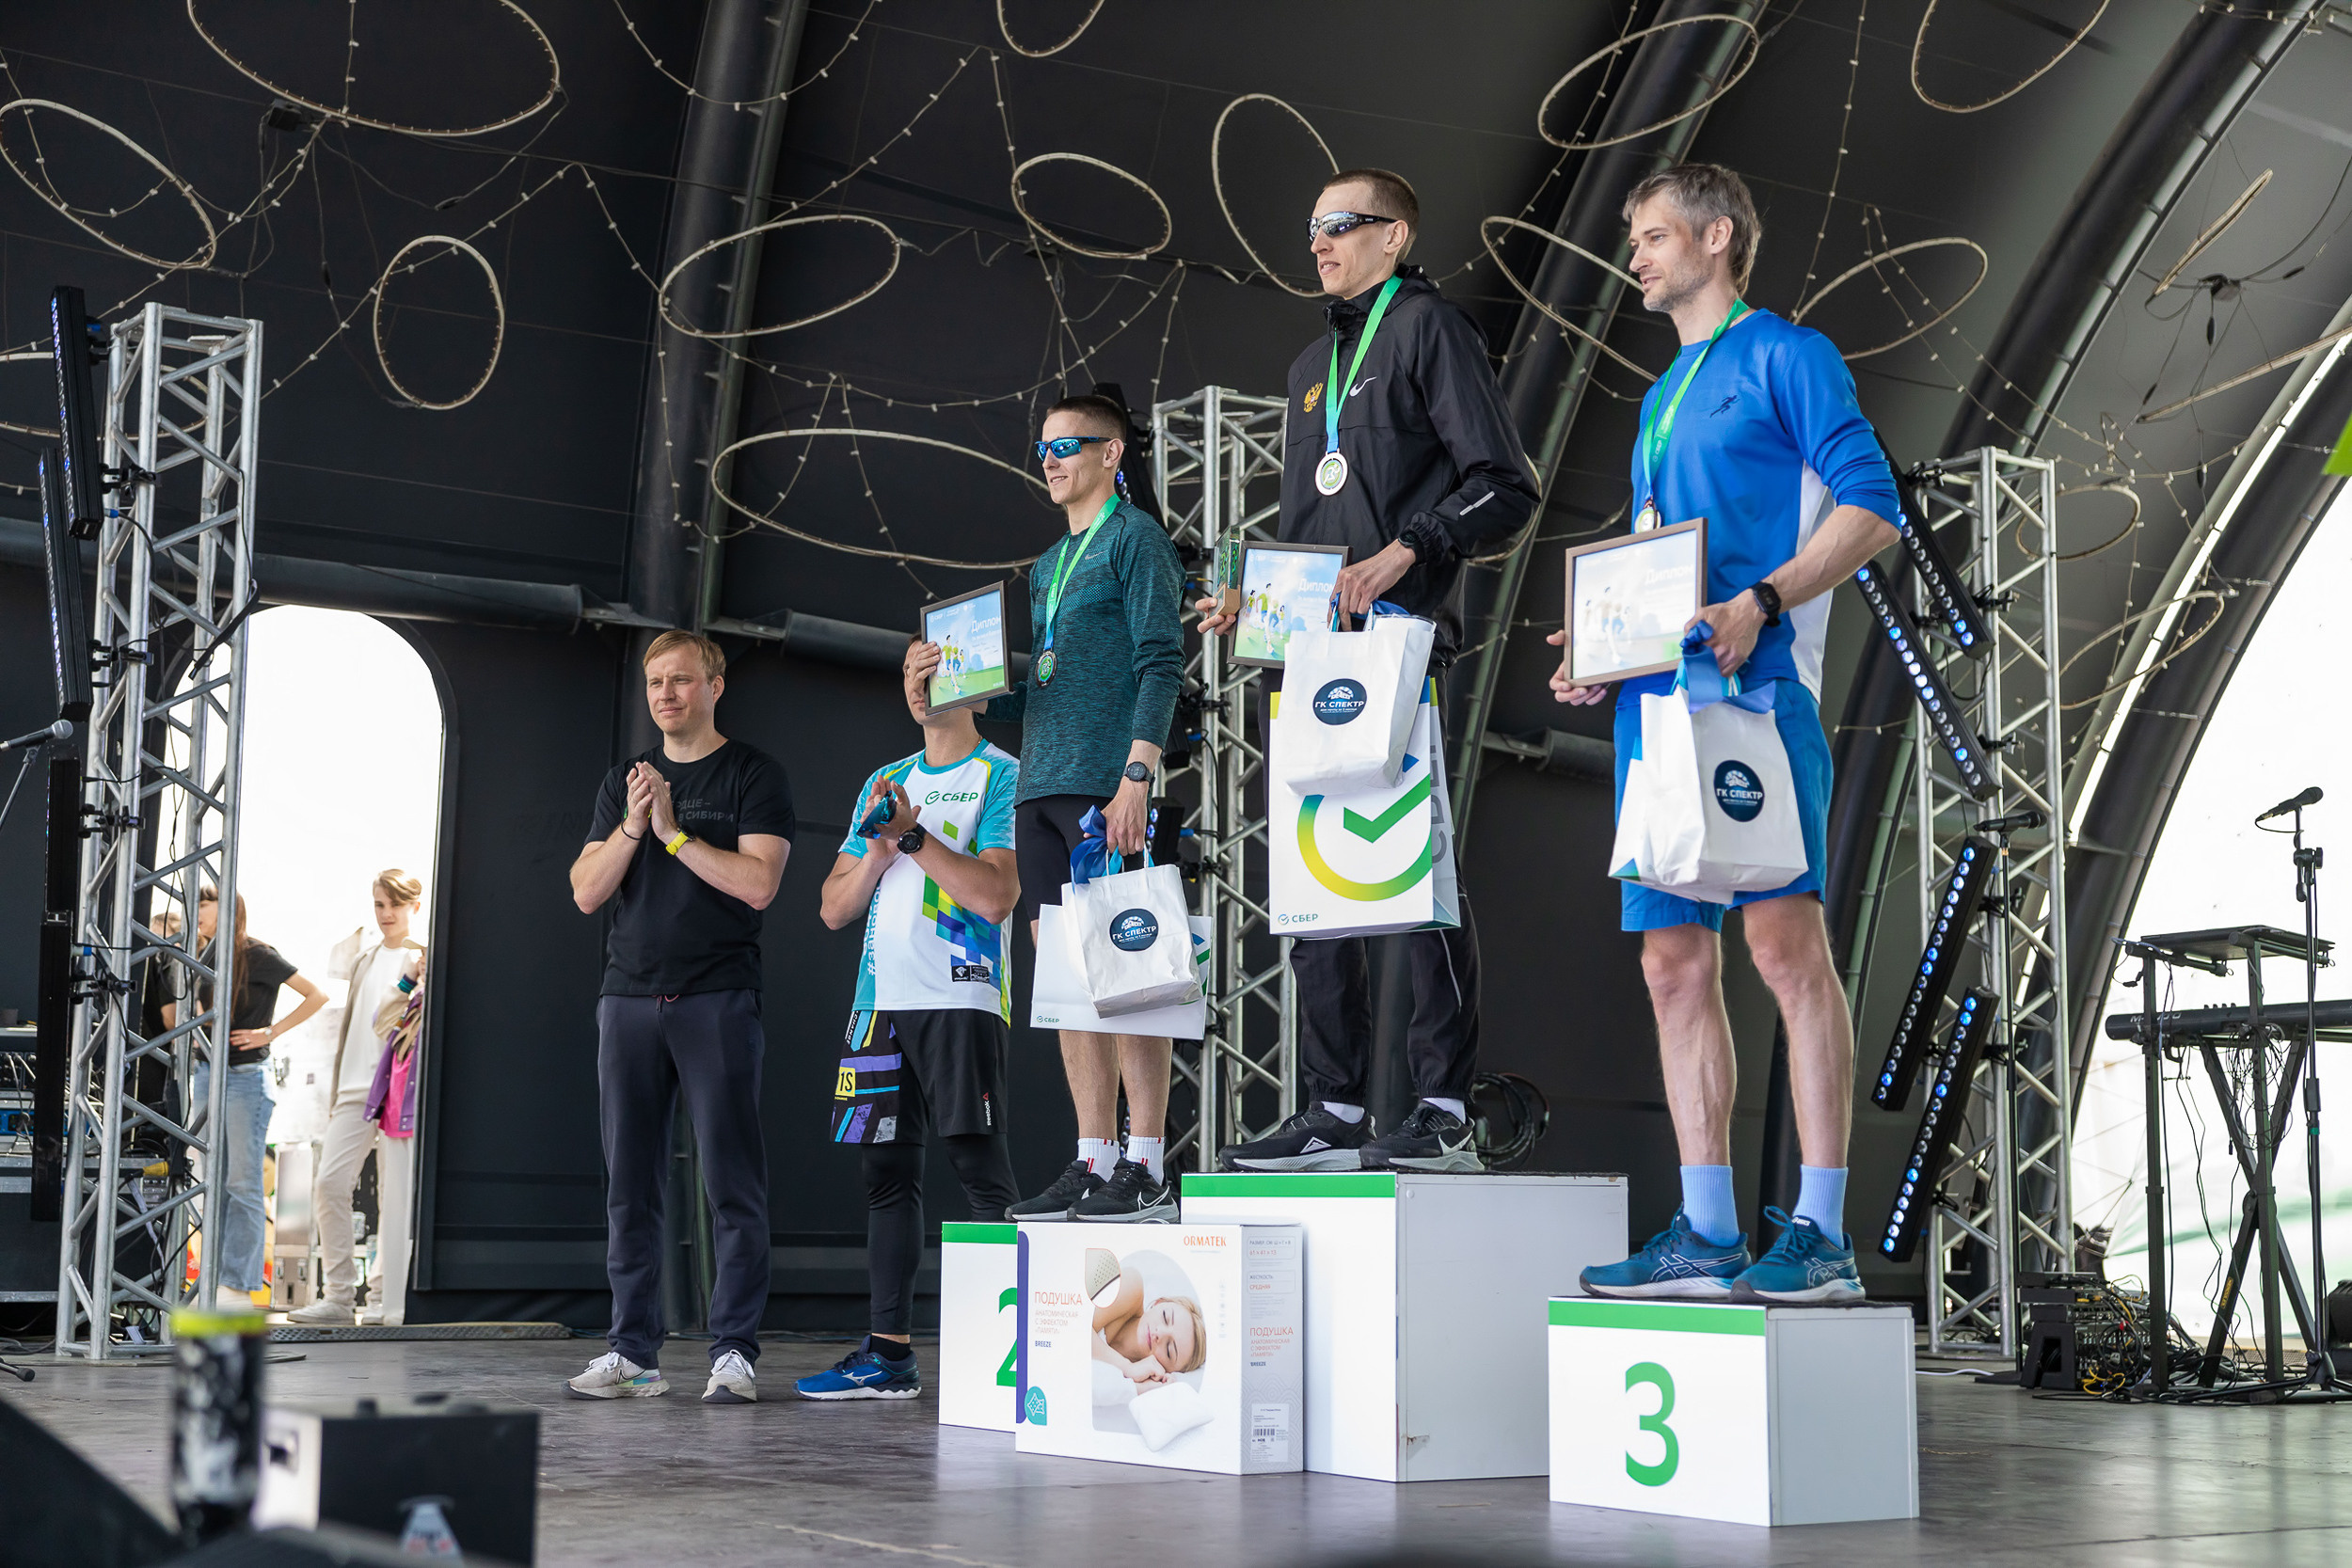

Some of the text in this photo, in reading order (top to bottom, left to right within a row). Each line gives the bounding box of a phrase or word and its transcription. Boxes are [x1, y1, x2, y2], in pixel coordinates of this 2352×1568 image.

[1645, 564, 1695, 584] Диплом
[1328, 700, 1365, 708] СПЕКТР
[942, 792, 978, 802] СБЕР
[1716, 788, 1763, 800] ГК СПЕКТР
[1292, 913, 1319, 923] СБЕР
[1112, 932, 1124, 941] ГК
[1124, 925, 1157, 938] СПЕКТР
[1183, 1235, 1227, 1247] ORMATEK
[1035, 1291, 1083, 1307] ПОДУШКА
[1249, 1326, 1295, 1338] ПОДУШКА
[1625, 1361, 1679, 1487] 3
